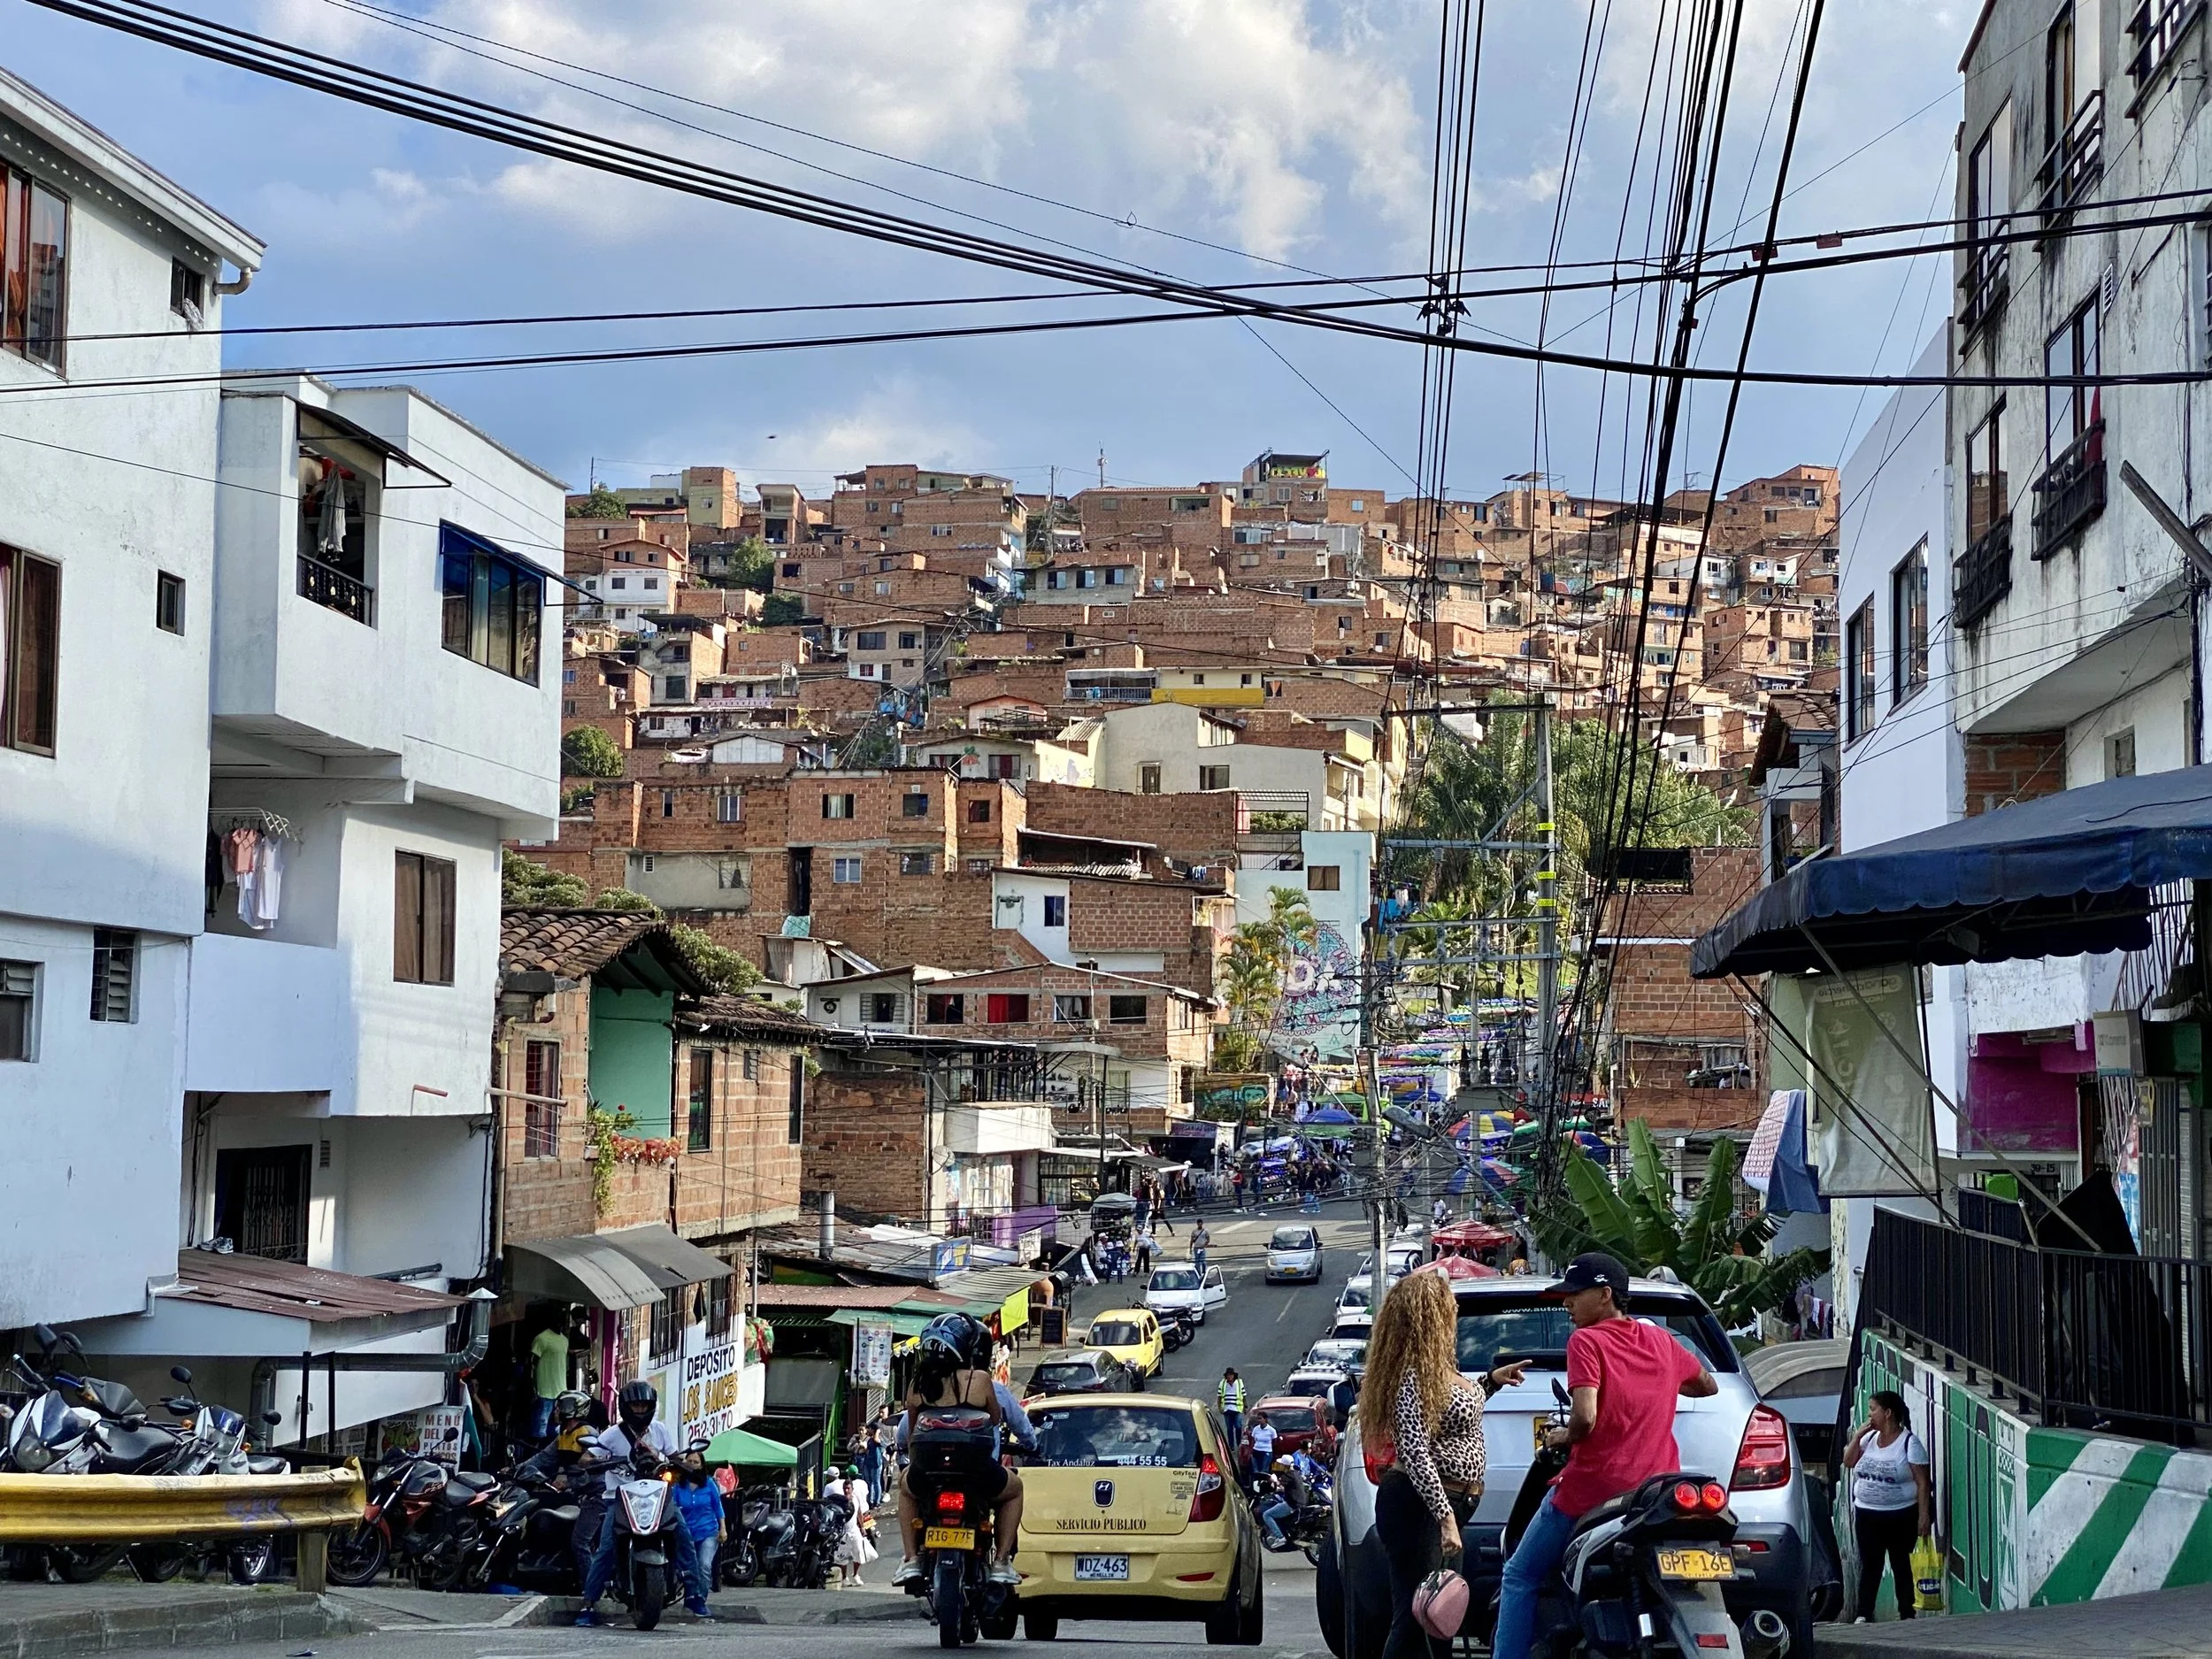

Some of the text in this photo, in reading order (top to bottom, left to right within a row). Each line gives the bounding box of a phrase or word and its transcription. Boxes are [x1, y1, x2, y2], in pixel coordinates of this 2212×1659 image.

[687, 1344, 735, 1382] DEPOSITO
[682, 1370, 739, 1425] LOS SAUCES
[424, 1428, 441, 1440] DEL
[1047, 1458, 1095, 1467] Tax Andaluz
[1117, 1455, 1168, 1466] 444 55 55
[927, 1530, 949, 1542] RIG
[1660, 1554, 1732, 1572] GPF 16E
